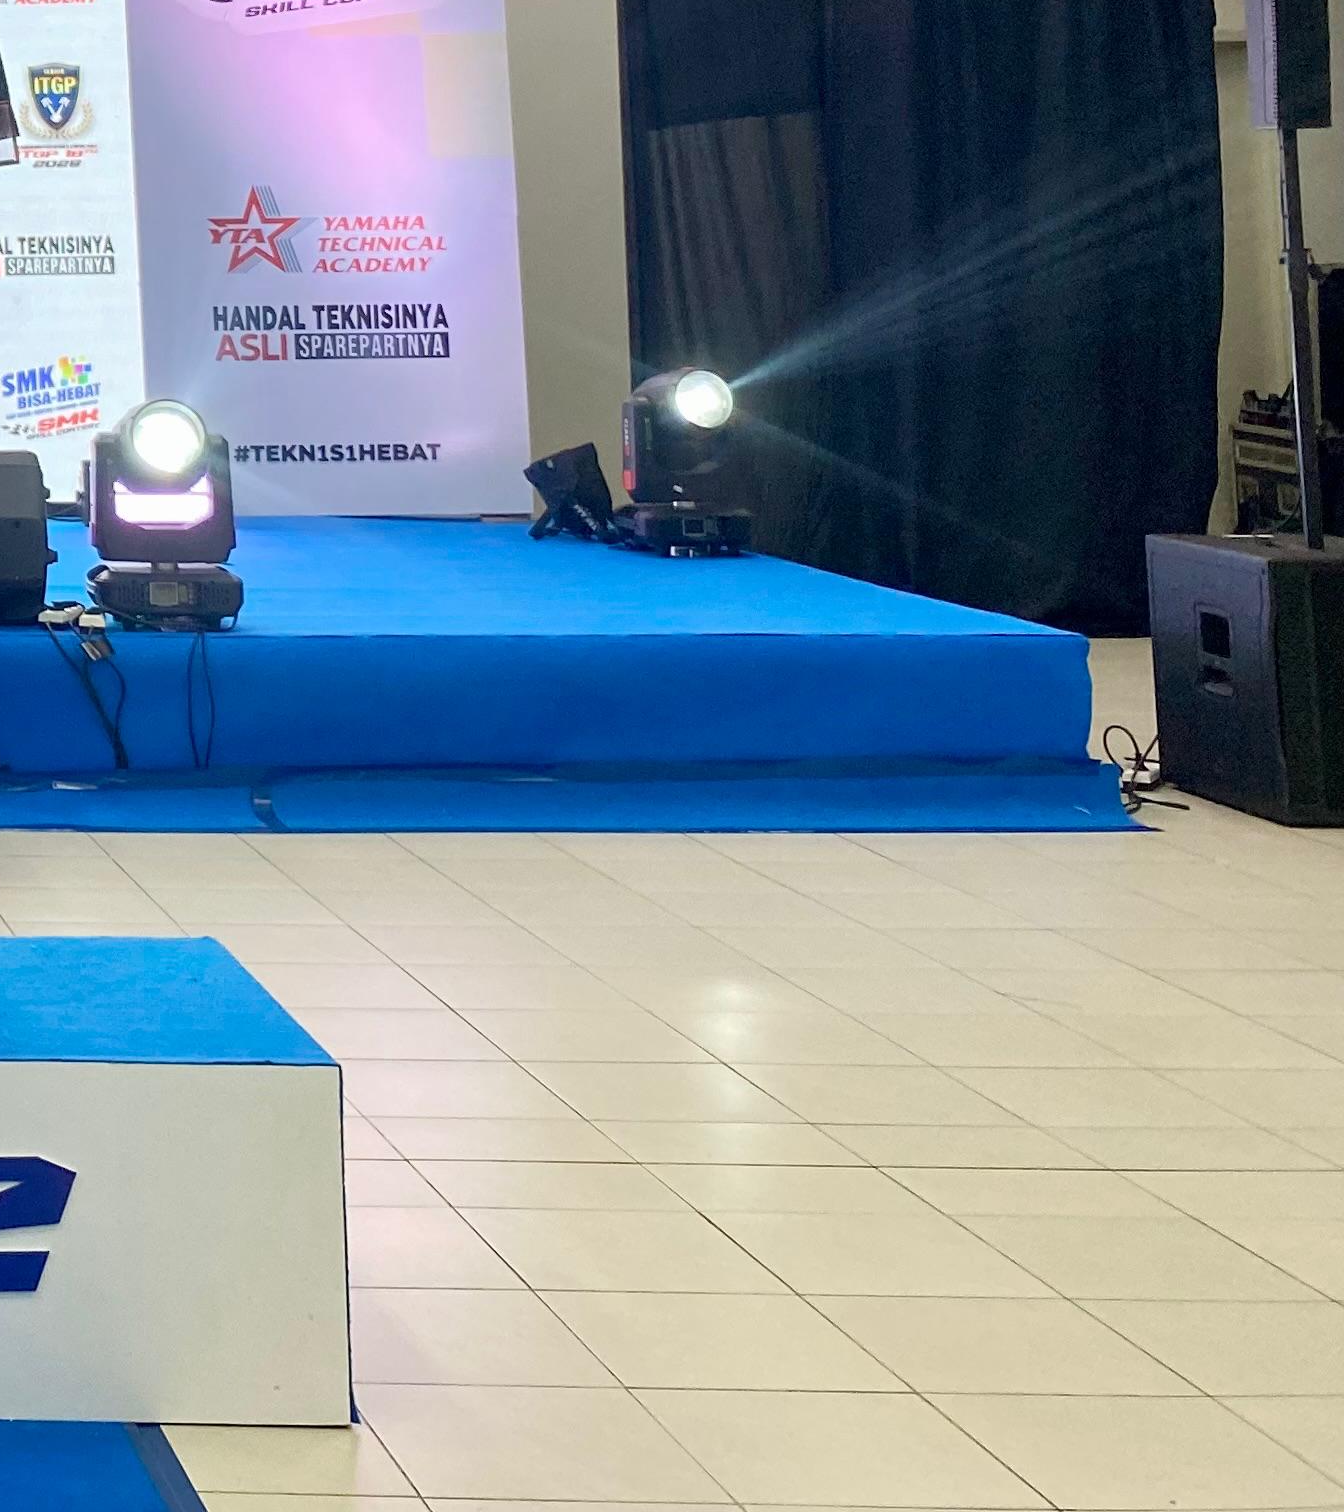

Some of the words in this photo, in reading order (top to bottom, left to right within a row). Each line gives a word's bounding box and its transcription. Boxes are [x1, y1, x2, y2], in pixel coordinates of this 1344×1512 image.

[244, 1, 313, 18] SKILL
[33, 76, 77, 96] ITGP
[324, 216, 425, 231] YAMAHA
[17, 235, 115, 255] TEKNISINYA
[209, 228, 266, 244] YTA
[318, 236, 448, 252] TECHNICAL
[6, 255, 112, 275] SPAREPARTNYA
[312, 257, 432, 273] ACADEMY
[213, 306, 306, 331] HANDAL
[313, 304, 449, 330] TEKNISINYA
[216, 334, 289, 361] ASLI
[296, 333, 446, 359] SPAREPARTNYA
[1, 368, 55, 397] SMK
[17, 382, 101, 410] BISA-HEBAT
[37, 407, 101, 433] SMK
[234, 444, 441, 463] #TEKN1S1HEBAT
